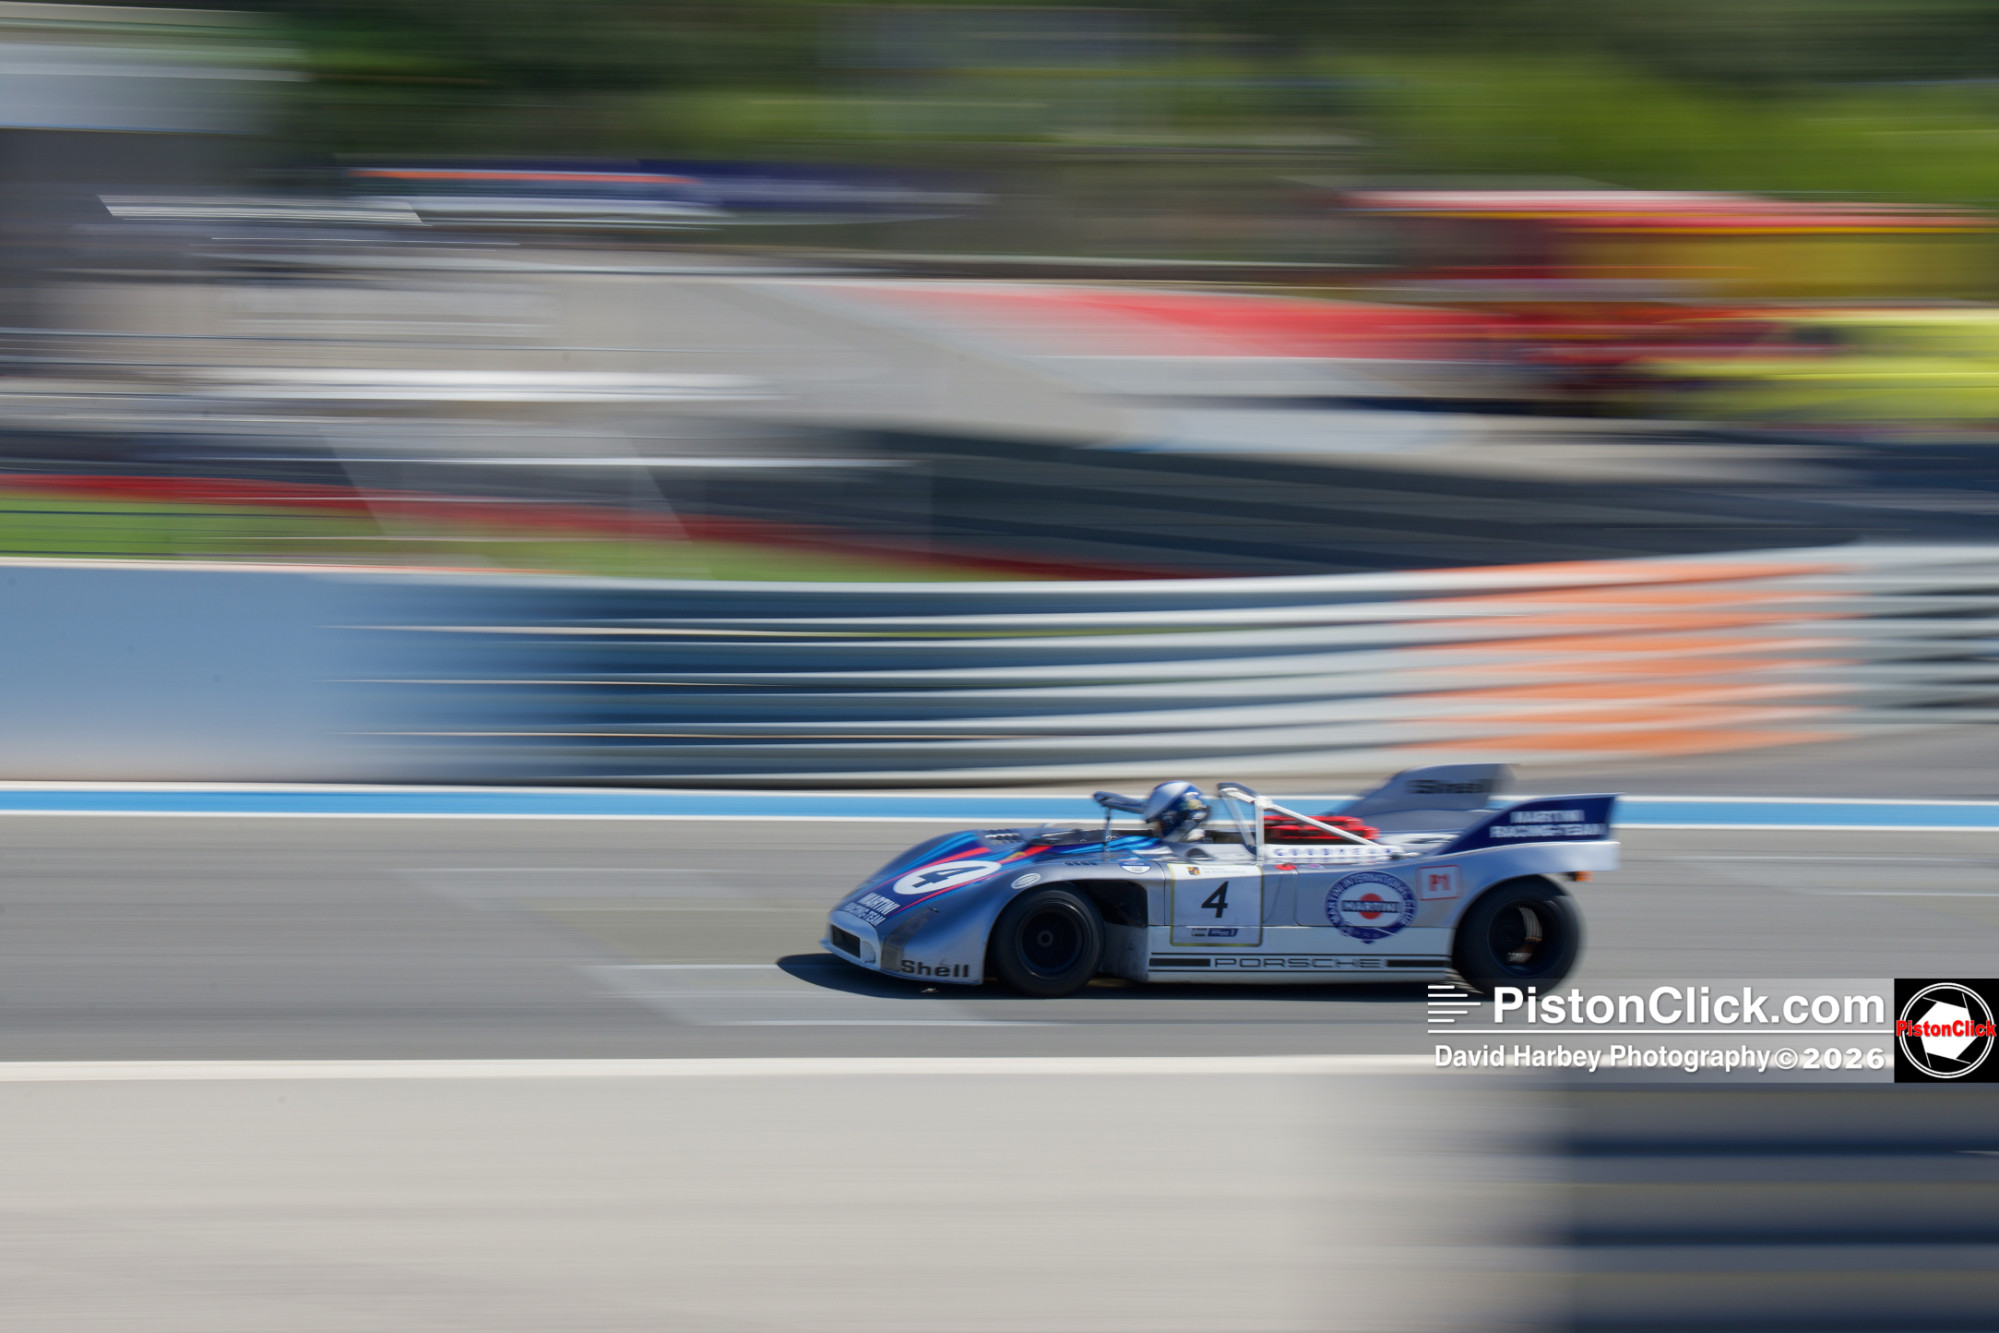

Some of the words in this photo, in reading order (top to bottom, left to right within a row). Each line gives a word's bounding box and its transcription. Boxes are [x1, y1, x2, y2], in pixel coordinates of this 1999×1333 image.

[1510, 809, 1585, 824] MARTINI
[911, 865, 989, 888] 4
[857, 892, 901, 916] MARTINI
[1201, 880, 1229, 918] 4
[1342, 901, 1399, 912] MARTINI
[901, 959, 970, 978] Shell
[1214, 957, 1386, 969] PORSCHE
